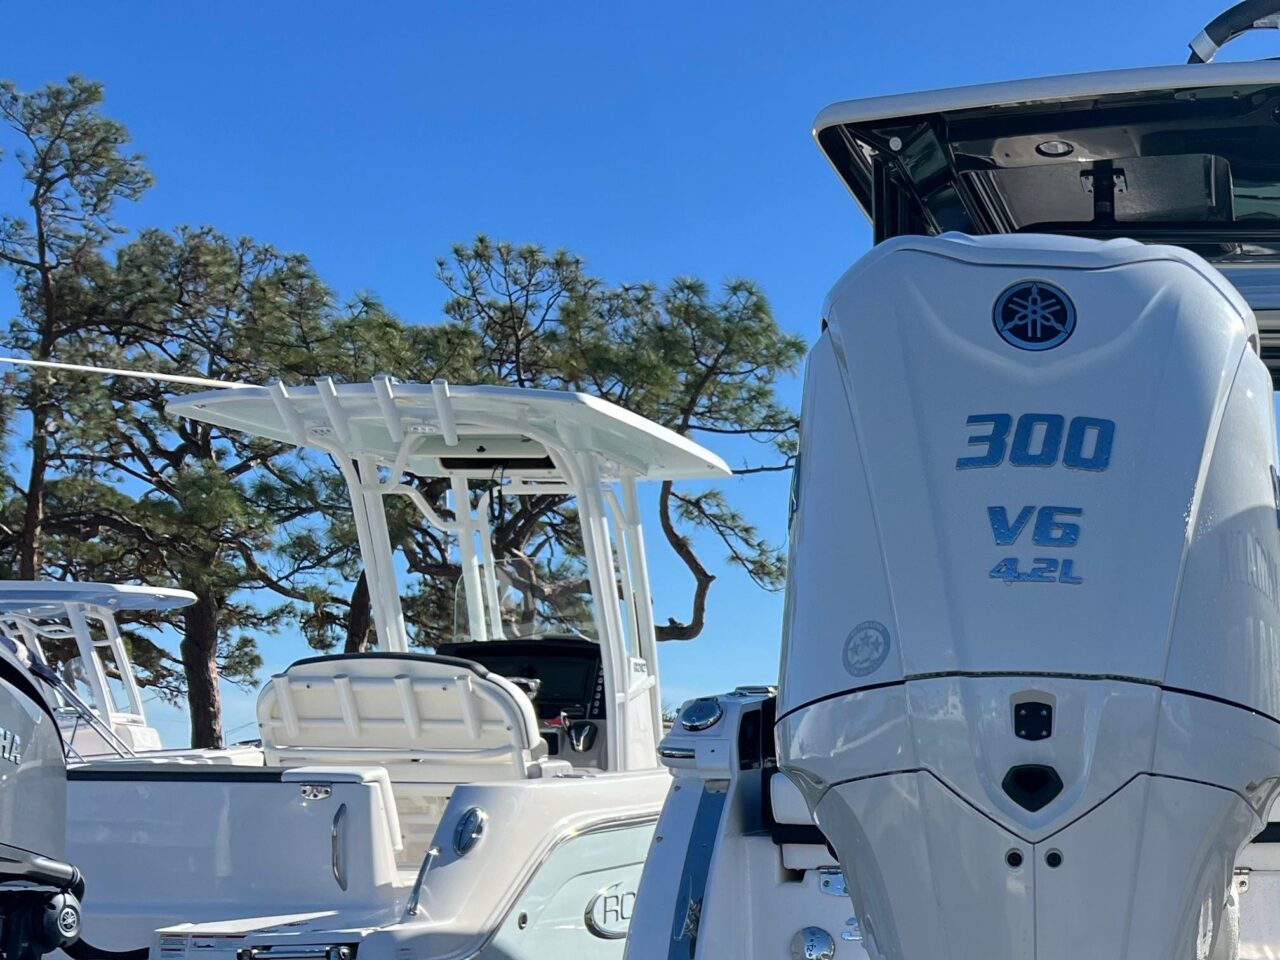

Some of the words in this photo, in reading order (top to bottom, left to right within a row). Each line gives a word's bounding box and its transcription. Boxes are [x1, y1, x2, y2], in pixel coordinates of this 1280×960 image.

[955, 413, 1116, 472] 300
[986, 505, 1084, 547] V6
[989, 557, 1084, 585] 4.2L
